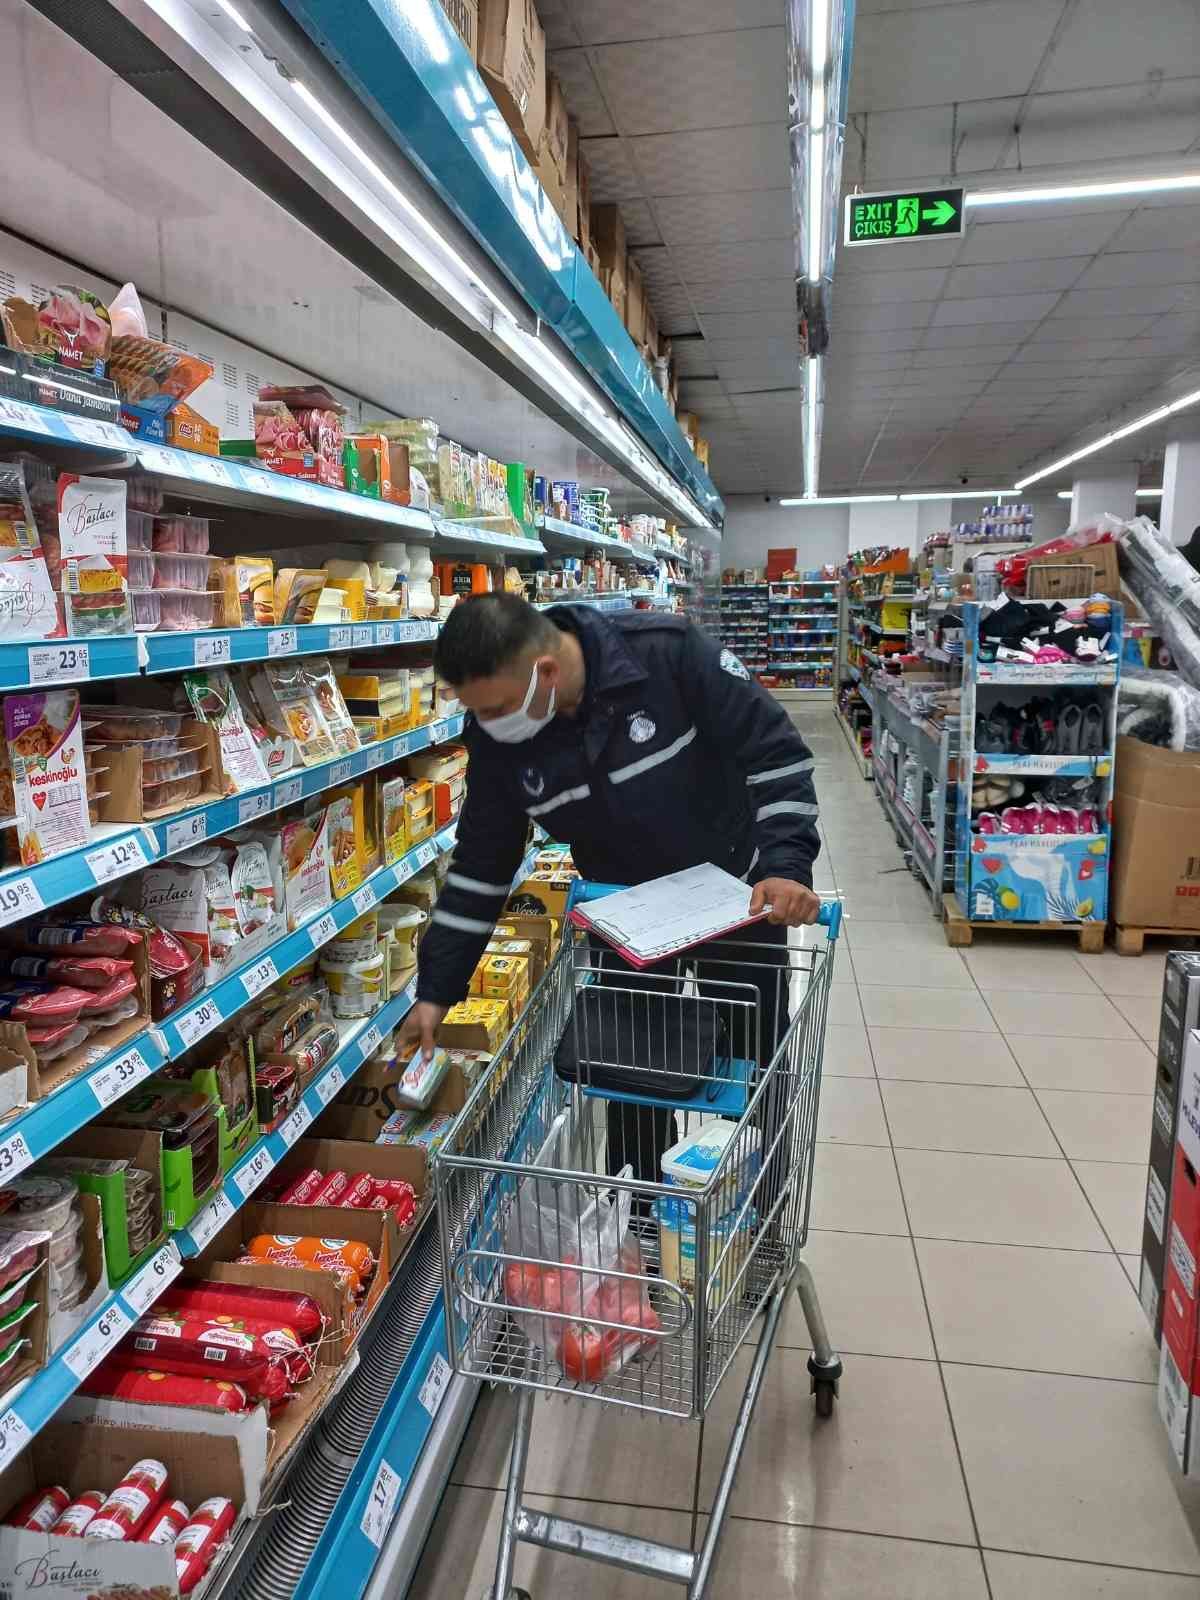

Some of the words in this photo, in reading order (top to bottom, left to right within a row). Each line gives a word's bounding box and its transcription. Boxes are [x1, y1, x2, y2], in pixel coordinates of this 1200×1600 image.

[855, 202, 893, 221] EXIT
[855, 220, 892, 237] ÇIKIŞ
[58, 345, 83, 361] NAMET
[28, 767, 79, 788] keskinoğlu
